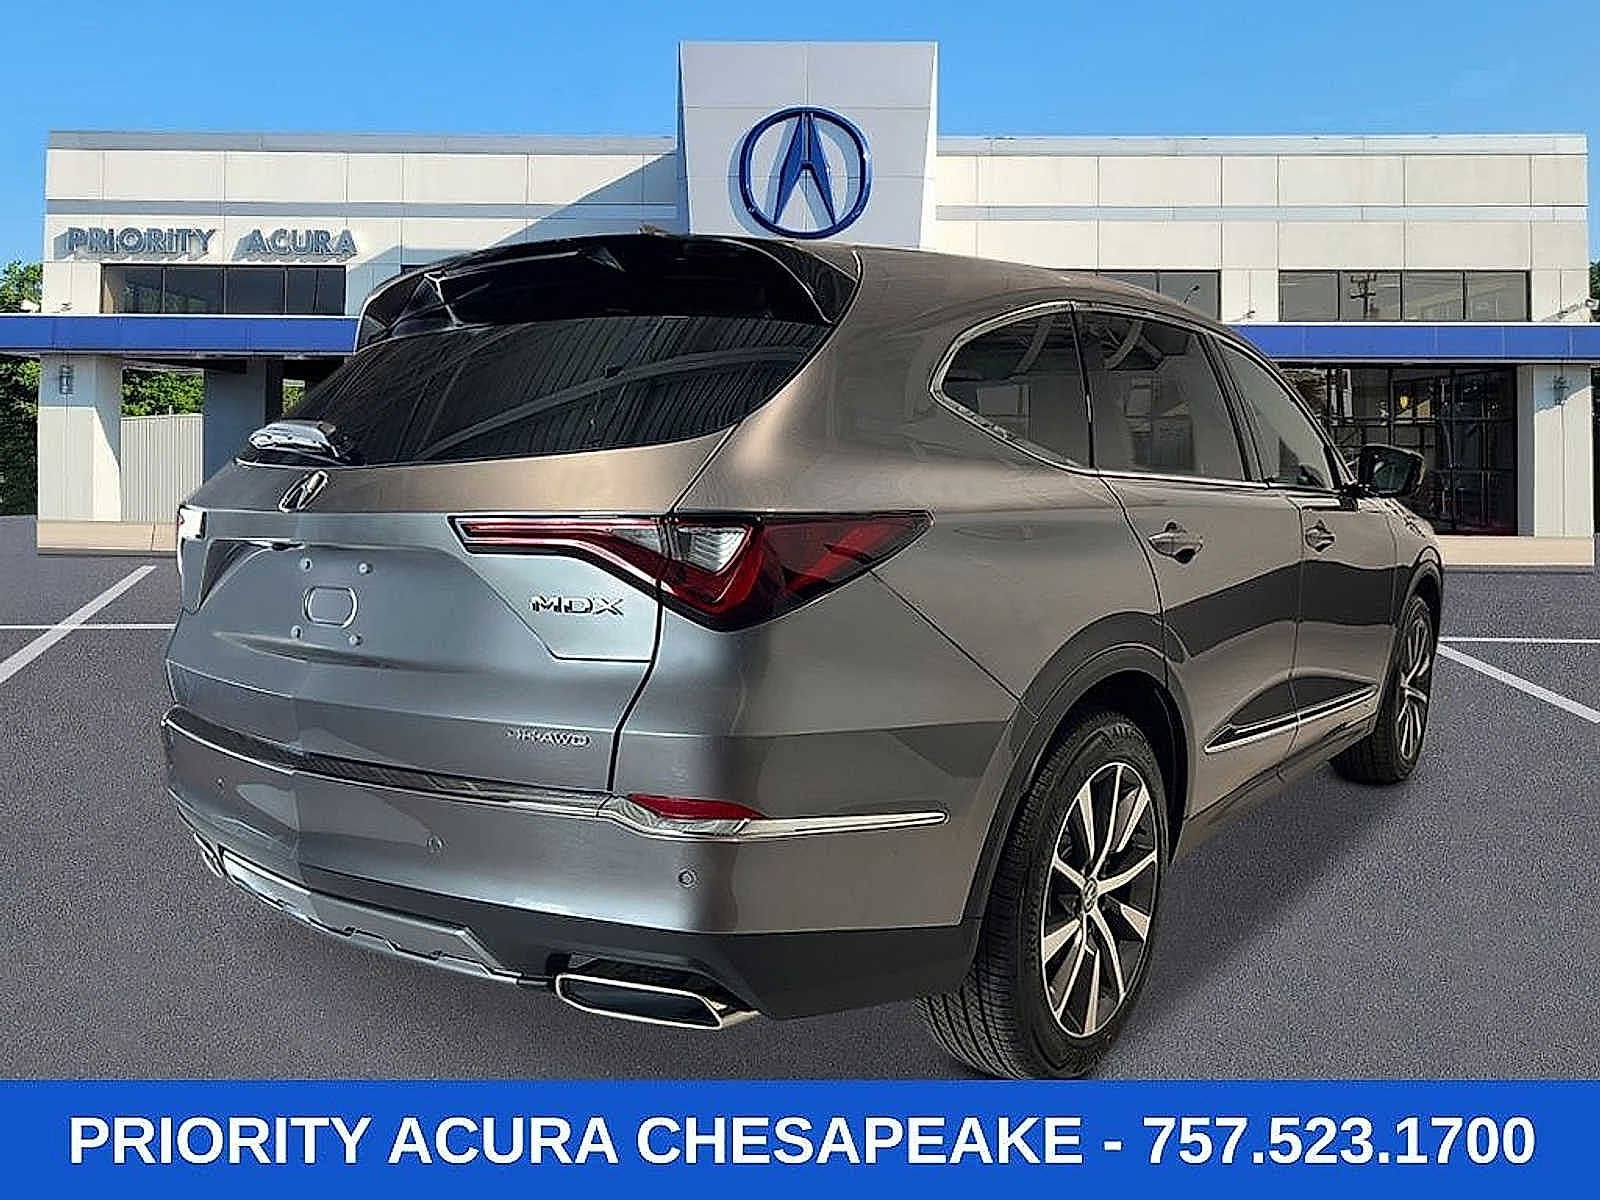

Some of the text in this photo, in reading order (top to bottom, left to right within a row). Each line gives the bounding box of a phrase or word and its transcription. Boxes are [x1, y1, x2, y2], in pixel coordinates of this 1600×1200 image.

[66, 227, 359, 255] PRIORITY ACURA
[529, 596, 625, 616] MDX
